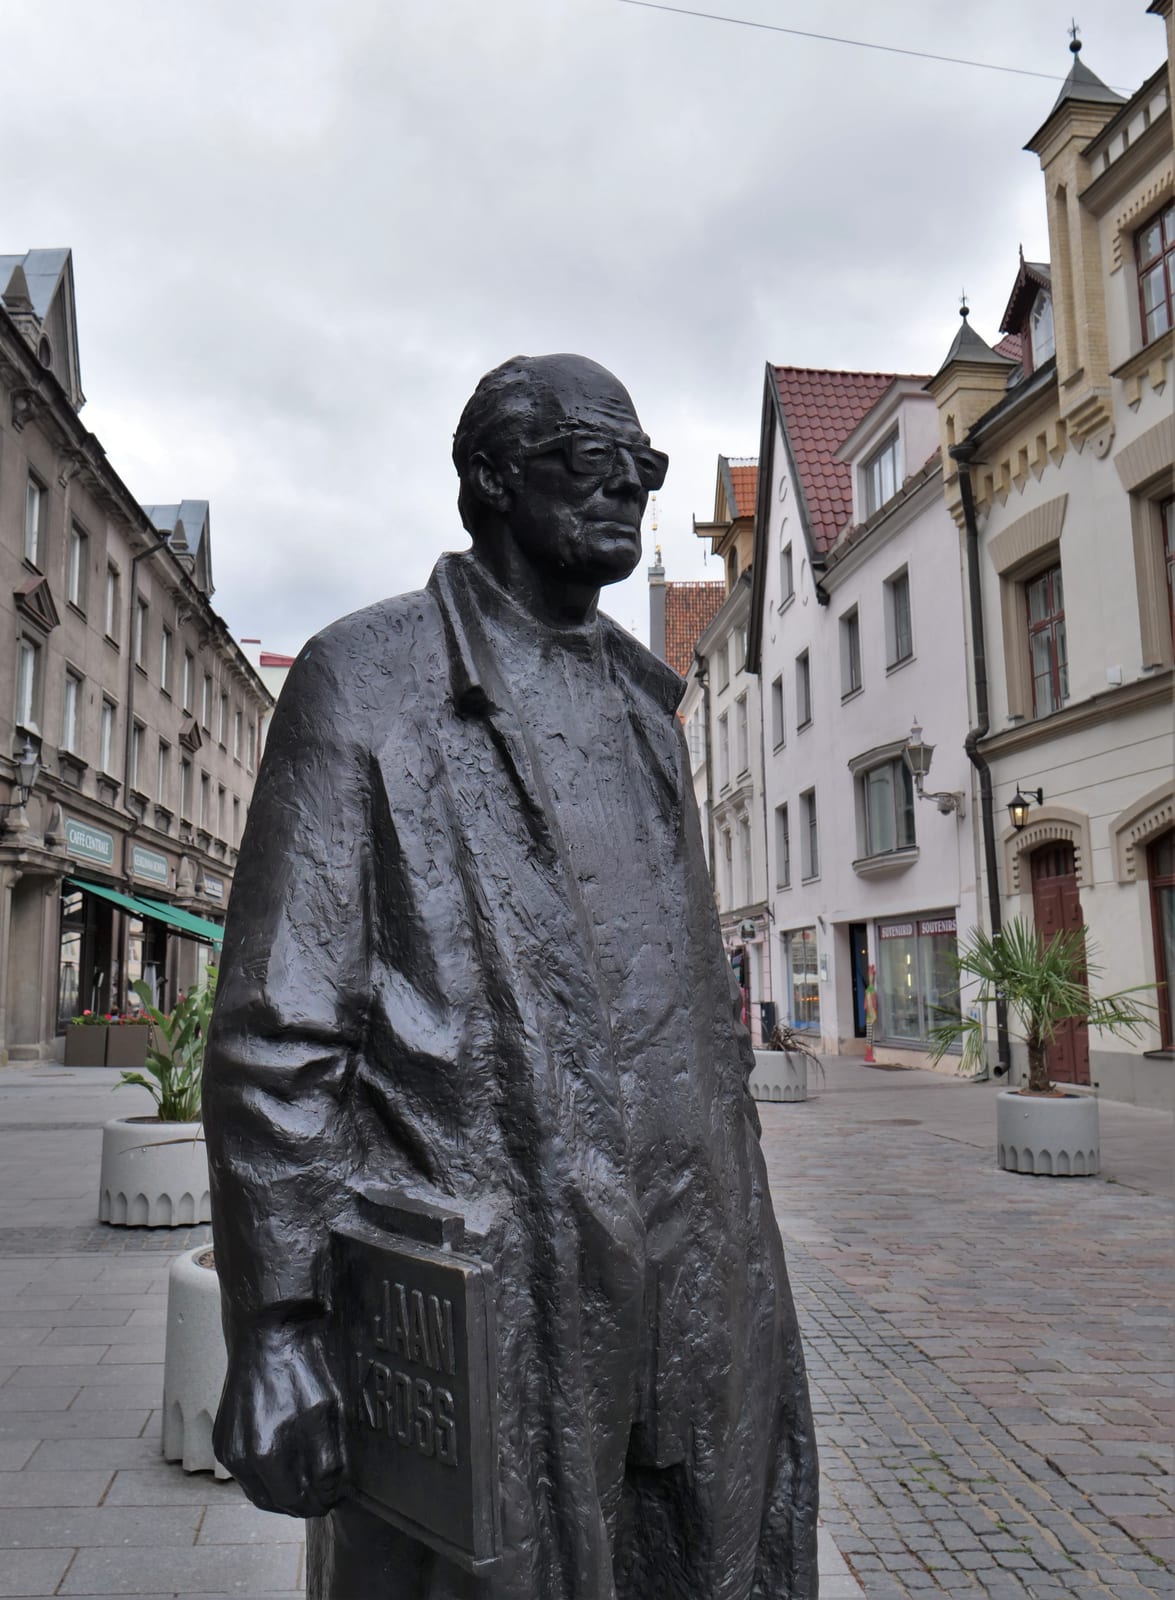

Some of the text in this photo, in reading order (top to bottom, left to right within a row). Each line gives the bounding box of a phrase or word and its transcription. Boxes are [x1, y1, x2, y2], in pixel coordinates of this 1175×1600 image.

[921, 919, 957, 934] SOUVENIRS
[374, 1279, 456, 1376] JAAN
[356, 1351, 458, 1467] KROSS
